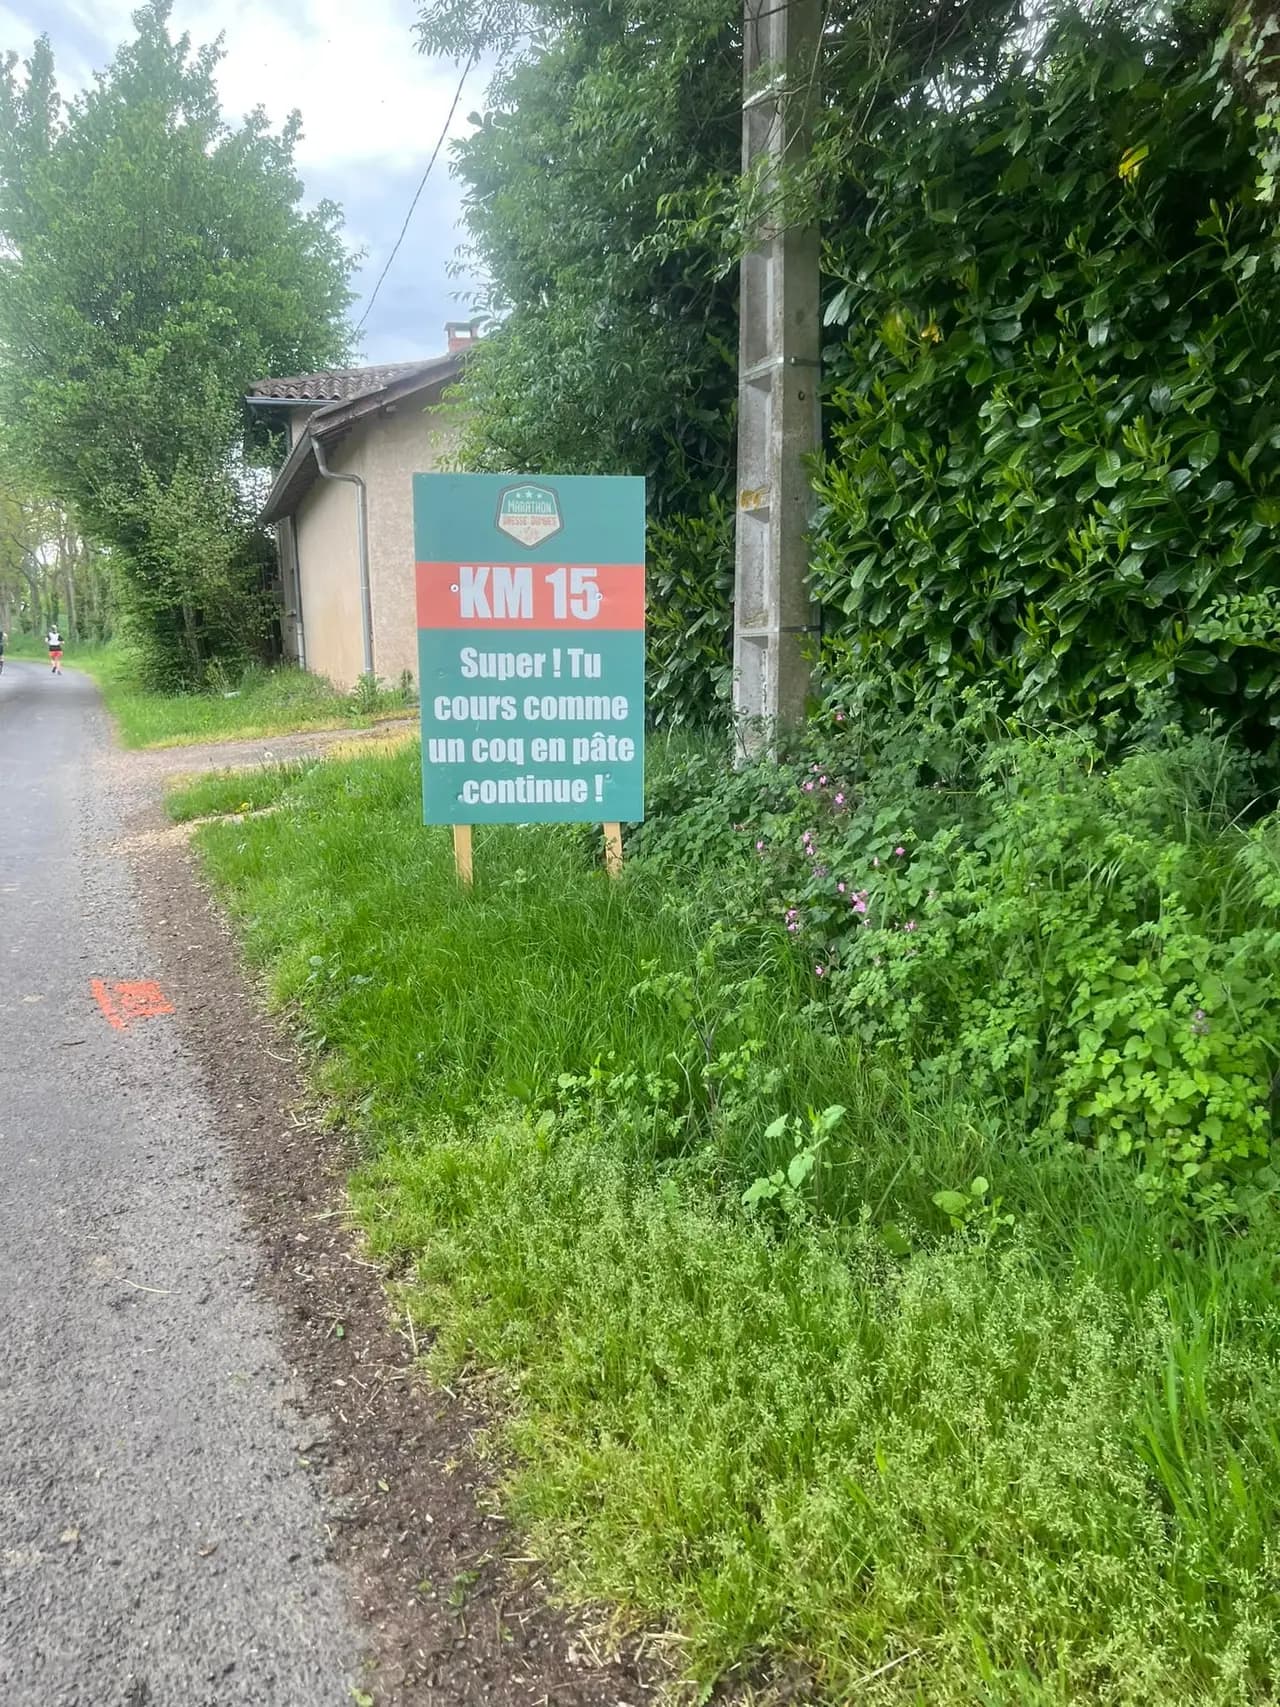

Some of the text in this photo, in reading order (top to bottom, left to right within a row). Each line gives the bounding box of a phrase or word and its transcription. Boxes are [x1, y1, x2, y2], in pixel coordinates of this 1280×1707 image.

[507, 500, 552, 513] MARATHON
[459, 567, 601, 620] KM 15
[460, 647, 546, 680] Super
[567, 648, 601, 678] Tu
[434, 695, 628, 721] cours comme
[429, 732, 635, 765] un coq en pâte
[463, 775, 588, 804] continue
